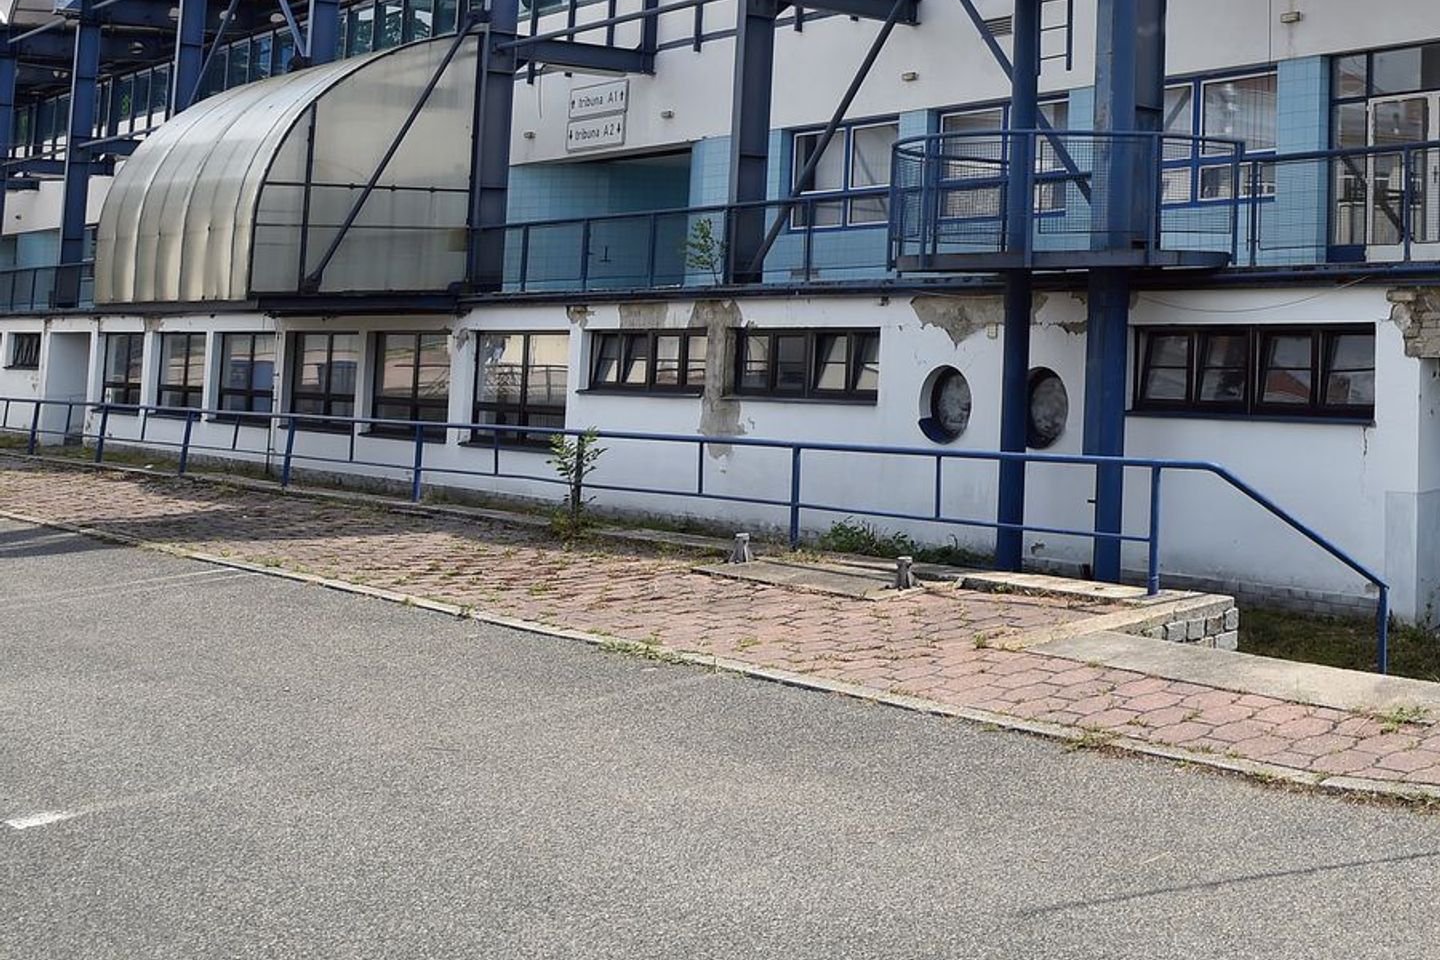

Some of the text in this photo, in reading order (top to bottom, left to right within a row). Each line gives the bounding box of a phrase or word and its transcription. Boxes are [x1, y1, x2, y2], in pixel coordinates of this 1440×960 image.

[578, 90, 618, 108] tribuna A1
[575, 123, 615, 140] tribuna A2
